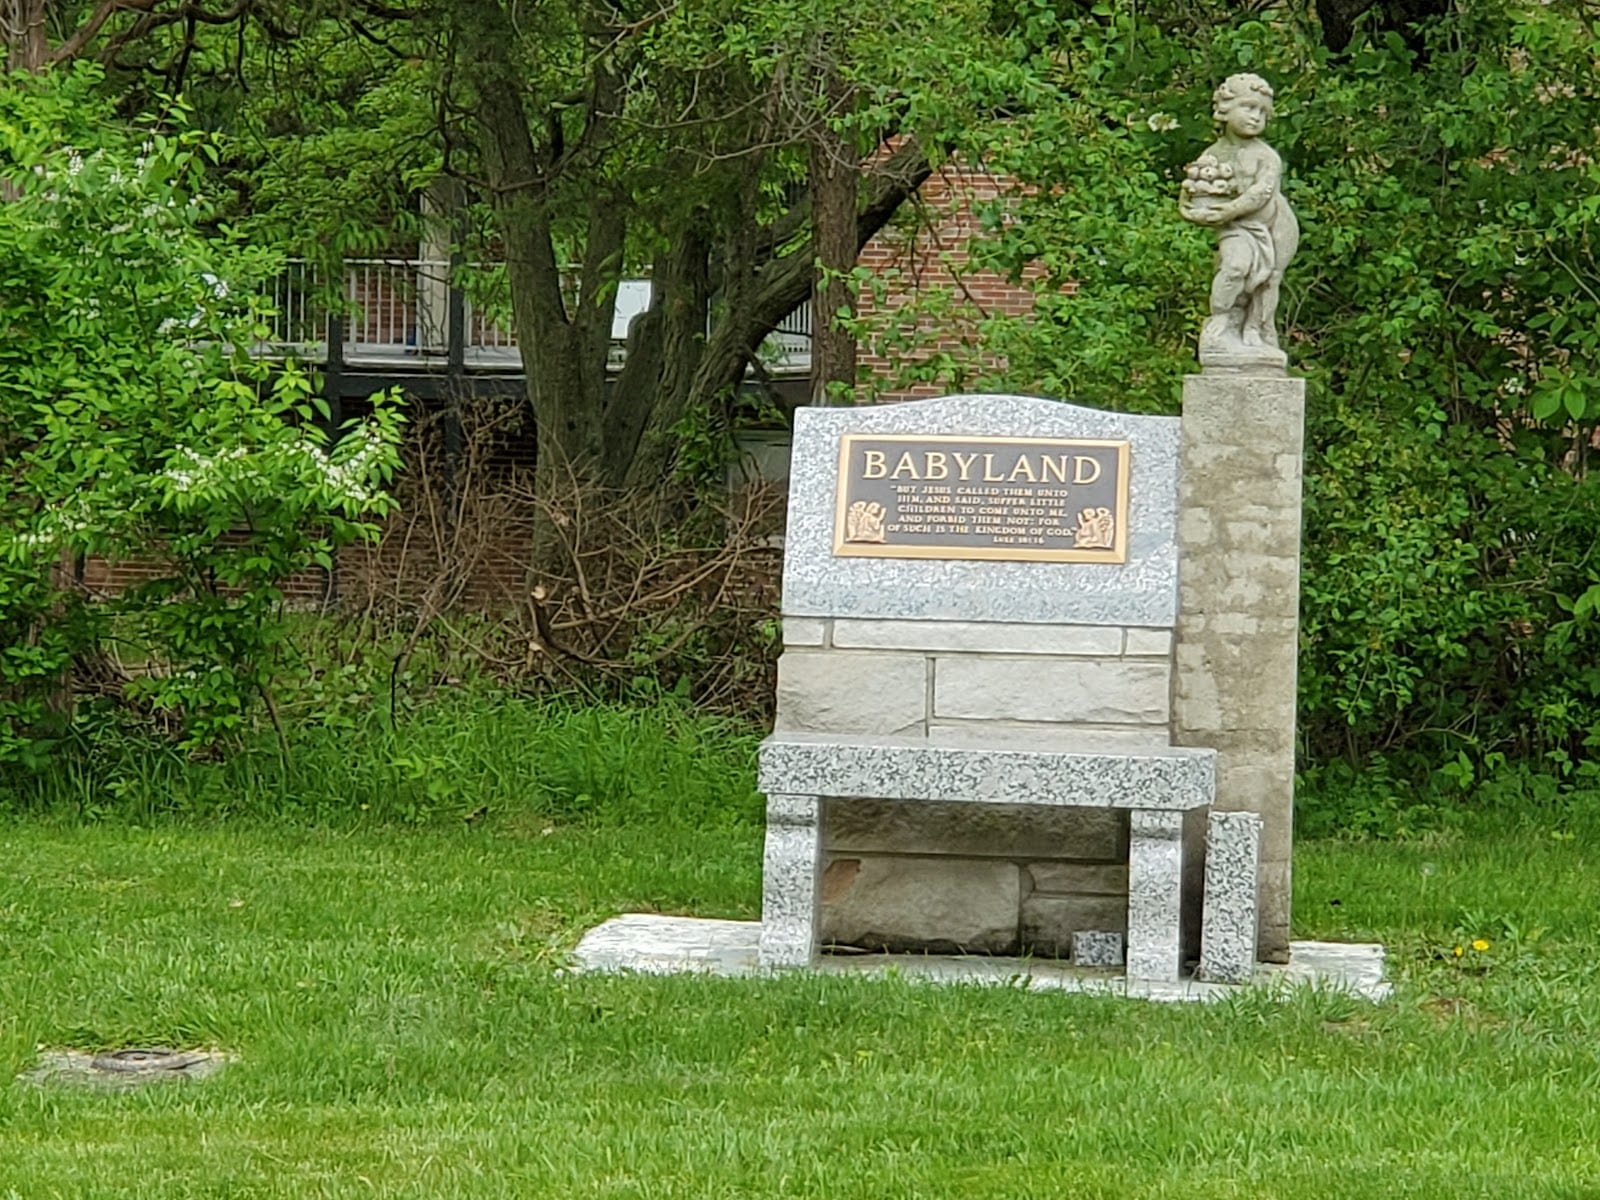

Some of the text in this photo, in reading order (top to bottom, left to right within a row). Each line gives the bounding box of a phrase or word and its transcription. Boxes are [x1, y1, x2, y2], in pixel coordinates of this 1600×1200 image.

[862, 450, 1101, 484] BABYLAND
[921, 485, 952, 494] JESUS
[957, 487, 999, 495] CALLED
[1003, 487, 1032, 496] THEM
[1037, 489, 1068, 497] UNTO
[925, 495, 951, 504] AND
[988, 497, 1025, 505] SUFFER
[1030, 498, 1065, 507] LITTLE
[897, 505, 956, 513] CHILDREN
[961, 506, 975, 514] TO
[979, 507, 1008, 515] COME
[1013, 508, 1044, 516] UNTO
[899, 514, 922, 523] AND
[927, 515, 966, 523] FORBID
[971, 516, 1001, 524] THEM
[1038, 517, 1060, 526] FOR
[887, 524, 900, 532] OF
[903, 524, 931, 533] SUCH
[935, 525, 945, 533] IS
[949, 525, 969, 534] THE
[975, 526, 1026, 534] KINGDOM
[1029, 527, 1043, 536] OF
